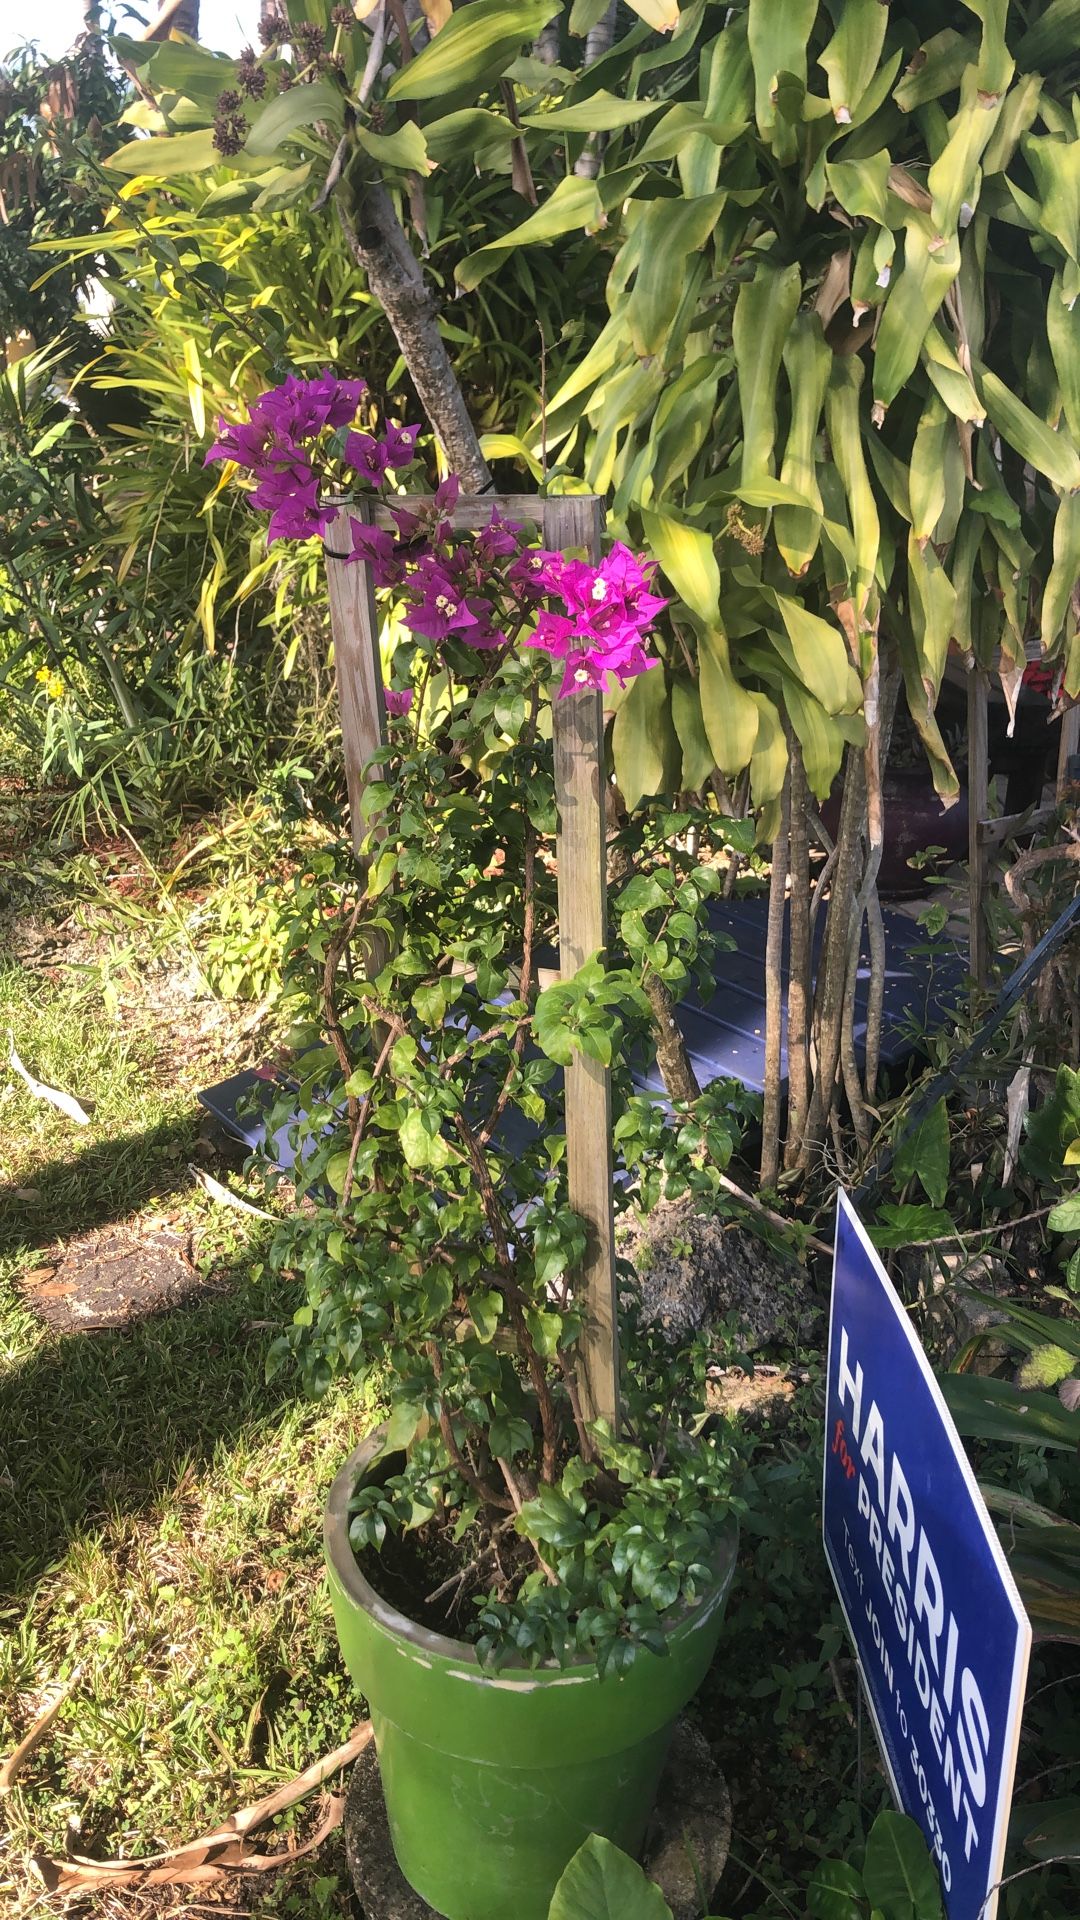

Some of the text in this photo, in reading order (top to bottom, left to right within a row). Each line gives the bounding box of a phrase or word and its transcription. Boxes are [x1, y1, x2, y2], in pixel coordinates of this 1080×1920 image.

[832, 1419, 856, 1480] for
[858, 1472, 979, 1864] PRESIDENT
[838, 1325, 990, 1808] HARRIS
[843, 1516, 865, 1596] Text
[865, 1598, 894, 1694] JOIN
[895, 1689, 909, 1739] to
[910, 1734, 952, 1893] 30330
